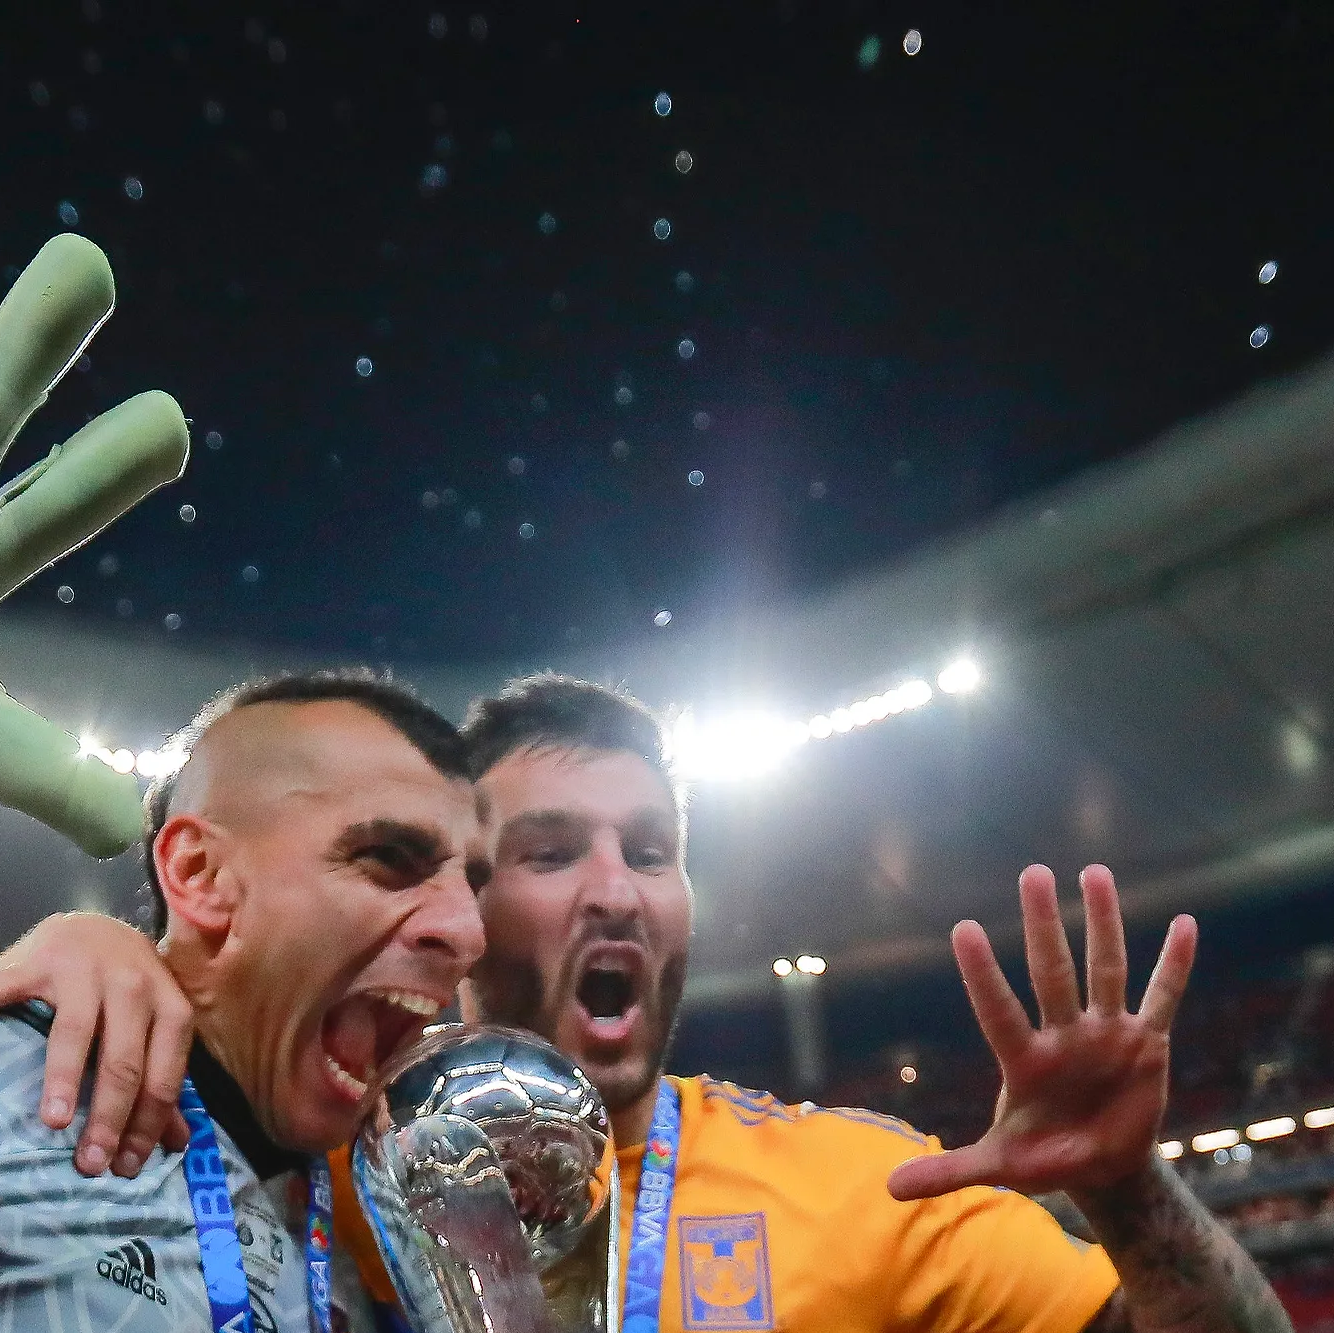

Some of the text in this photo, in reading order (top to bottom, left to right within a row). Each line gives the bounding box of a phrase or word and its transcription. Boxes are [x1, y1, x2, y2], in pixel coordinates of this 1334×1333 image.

[184, 1108, 236, 1223] BBV
[637, 1169, 670, 1248] BBVA
[96, 1258, 168, 1306] adidas
